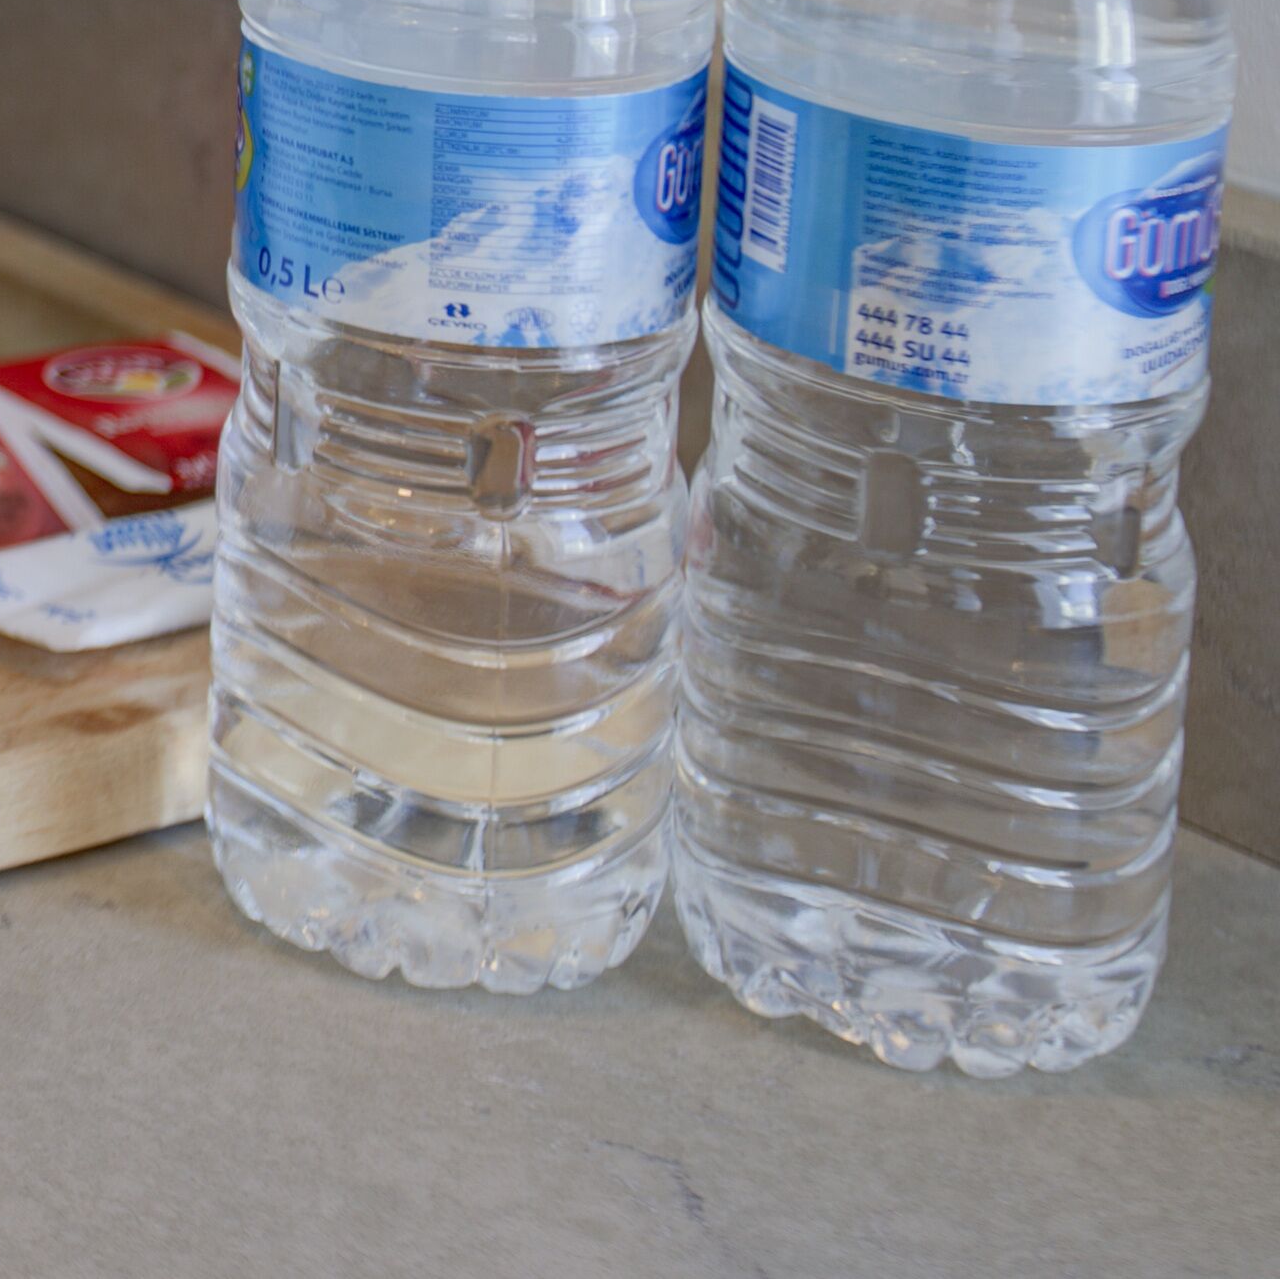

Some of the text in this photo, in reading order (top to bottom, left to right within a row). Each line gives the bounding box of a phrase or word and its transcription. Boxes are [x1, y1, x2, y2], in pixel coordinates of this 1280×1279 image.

[258, 245, 294, 288] 0,5
[857, 303, 970, 339] 444 78 44
[855, 328, 971, 367] 444 SU 44
